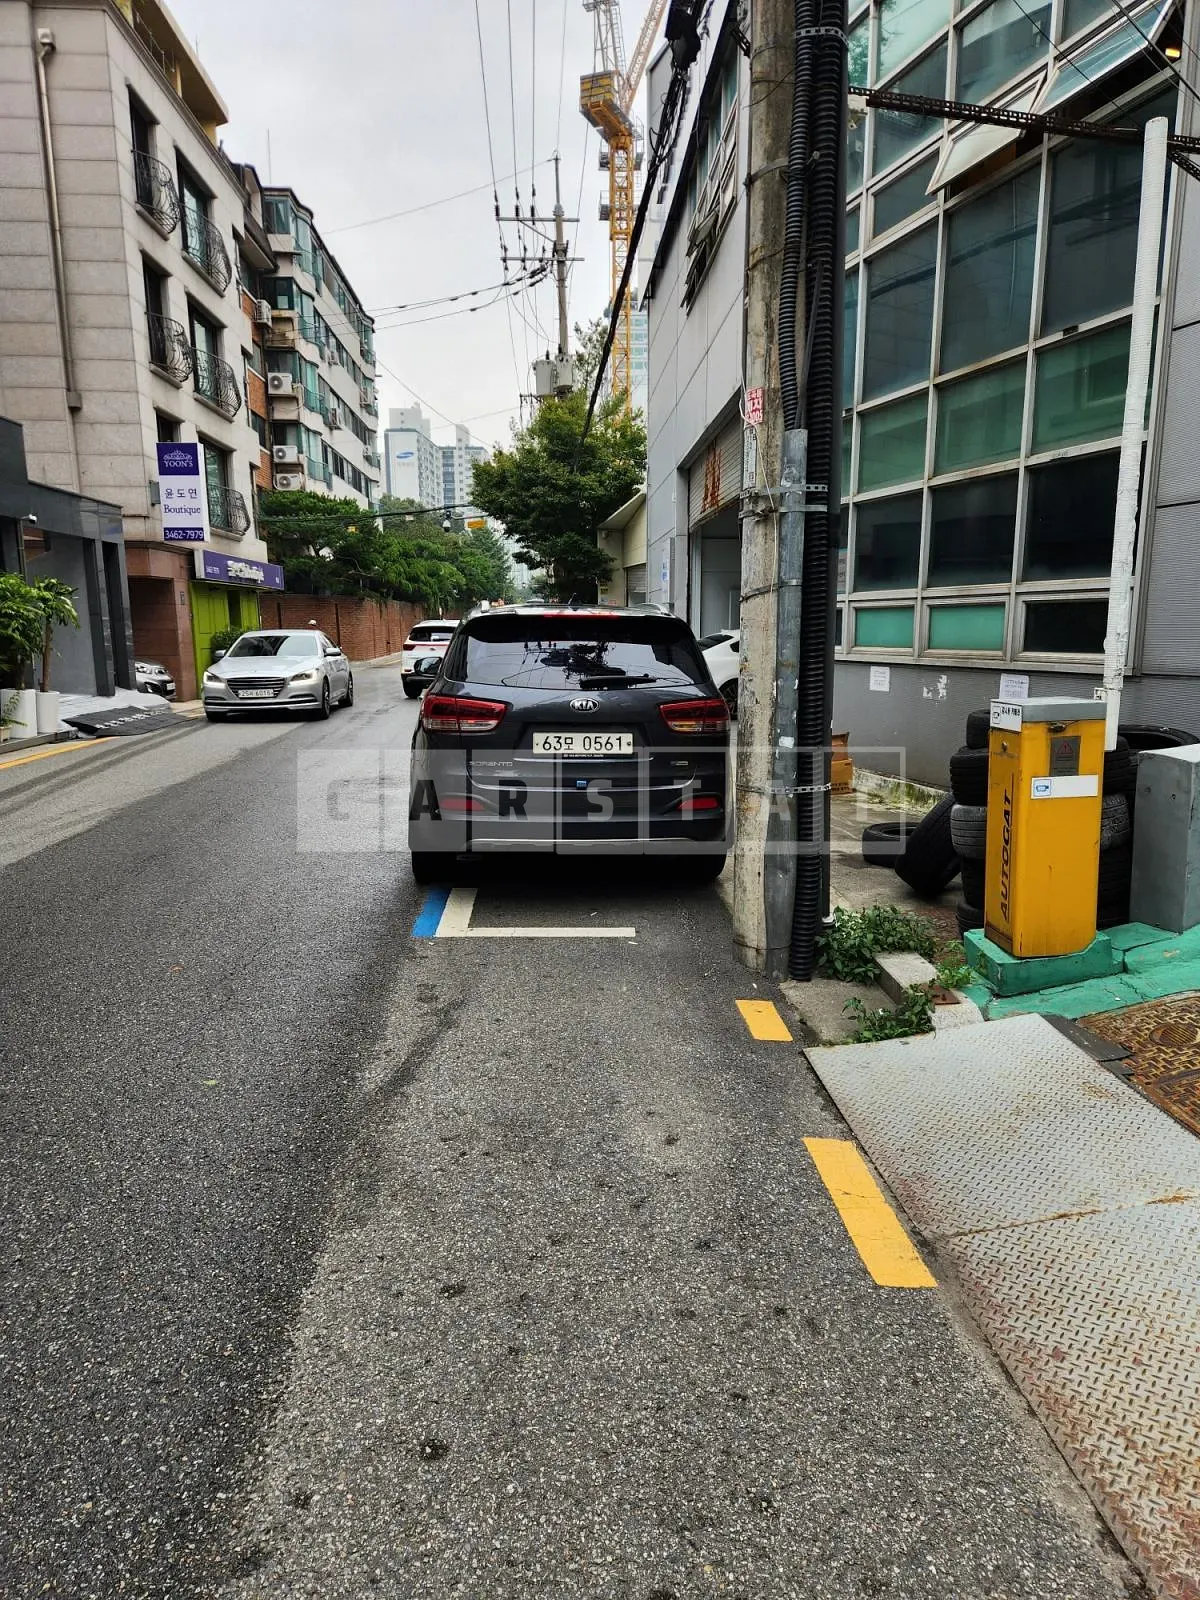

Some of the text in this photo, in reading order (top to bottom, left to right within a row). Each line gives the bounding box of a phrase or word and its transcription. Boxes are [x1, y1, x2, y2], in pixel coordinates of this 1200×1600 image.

[163, 504, 201, 516] Boutique
[164, 530, 204, 539] 3462-7979
[572, 699, 596, 711] KIA
[542, 735, 622, 751] 63모 0561
